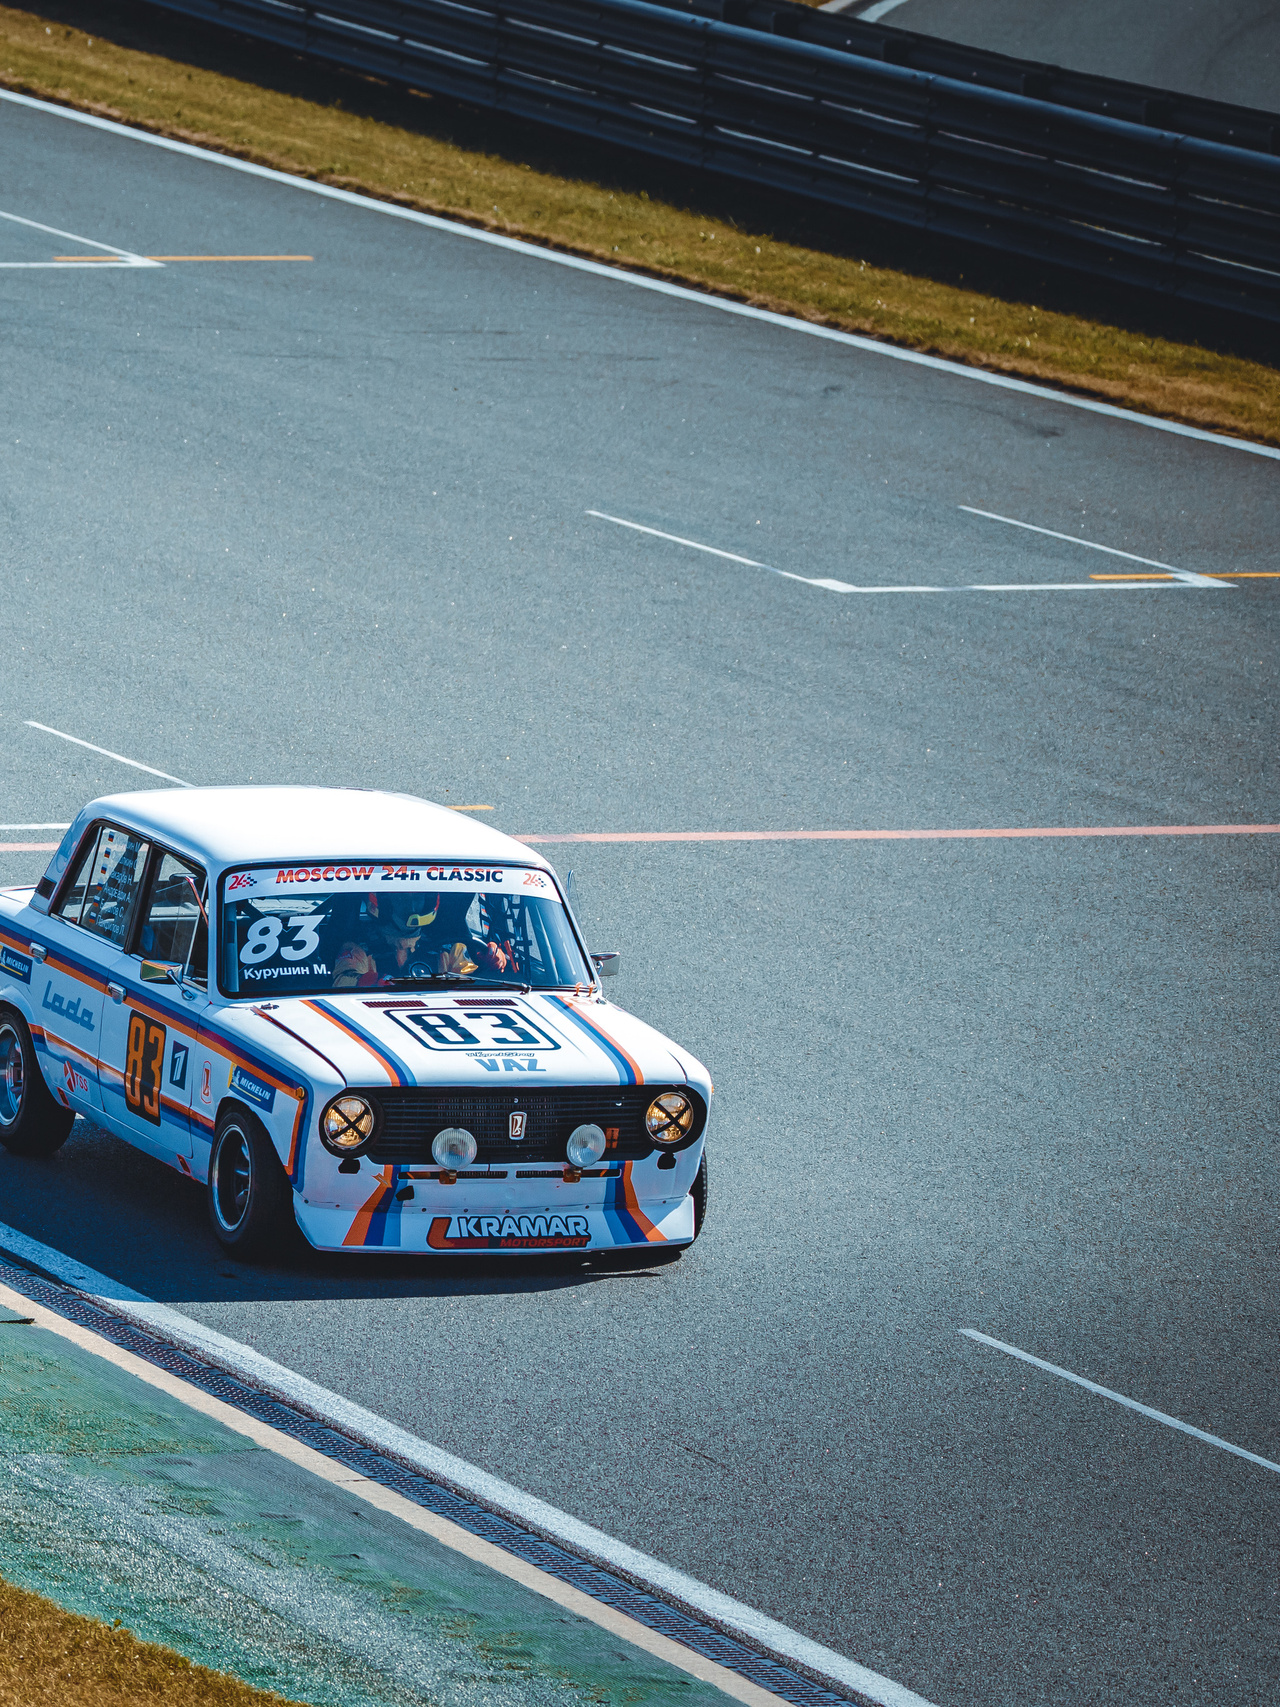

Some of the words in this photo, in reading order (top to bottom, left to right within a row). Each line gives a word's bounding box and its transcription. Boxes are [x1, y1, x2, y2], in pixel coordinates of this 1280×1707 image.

[275, 867, 375, 884] MOSCOW
[381, 866, 420, 881] 24h
[426, 867, 503, 882] CLASSIC
[239, 914, 325, 964] 83
[6, 955, 30, 974] MICHELIN
[244, 963, 310, 980] Курушин
[313, 964, 331, 975] М.
[42, 980, 95, 1032] Lada
[406, 1013, 540, 1044] 83
[127, 1016, 165, 1118] 83
[474, 1059, 546, 1072] VAZ
[74, 1071, 88, 1092] TSS
[240, 1077, 271, 1101] MICHELIN
[458, 1216, 590, 1238] KRAMAR
[499, 1237, 590, 1248] MOTORSPORT
